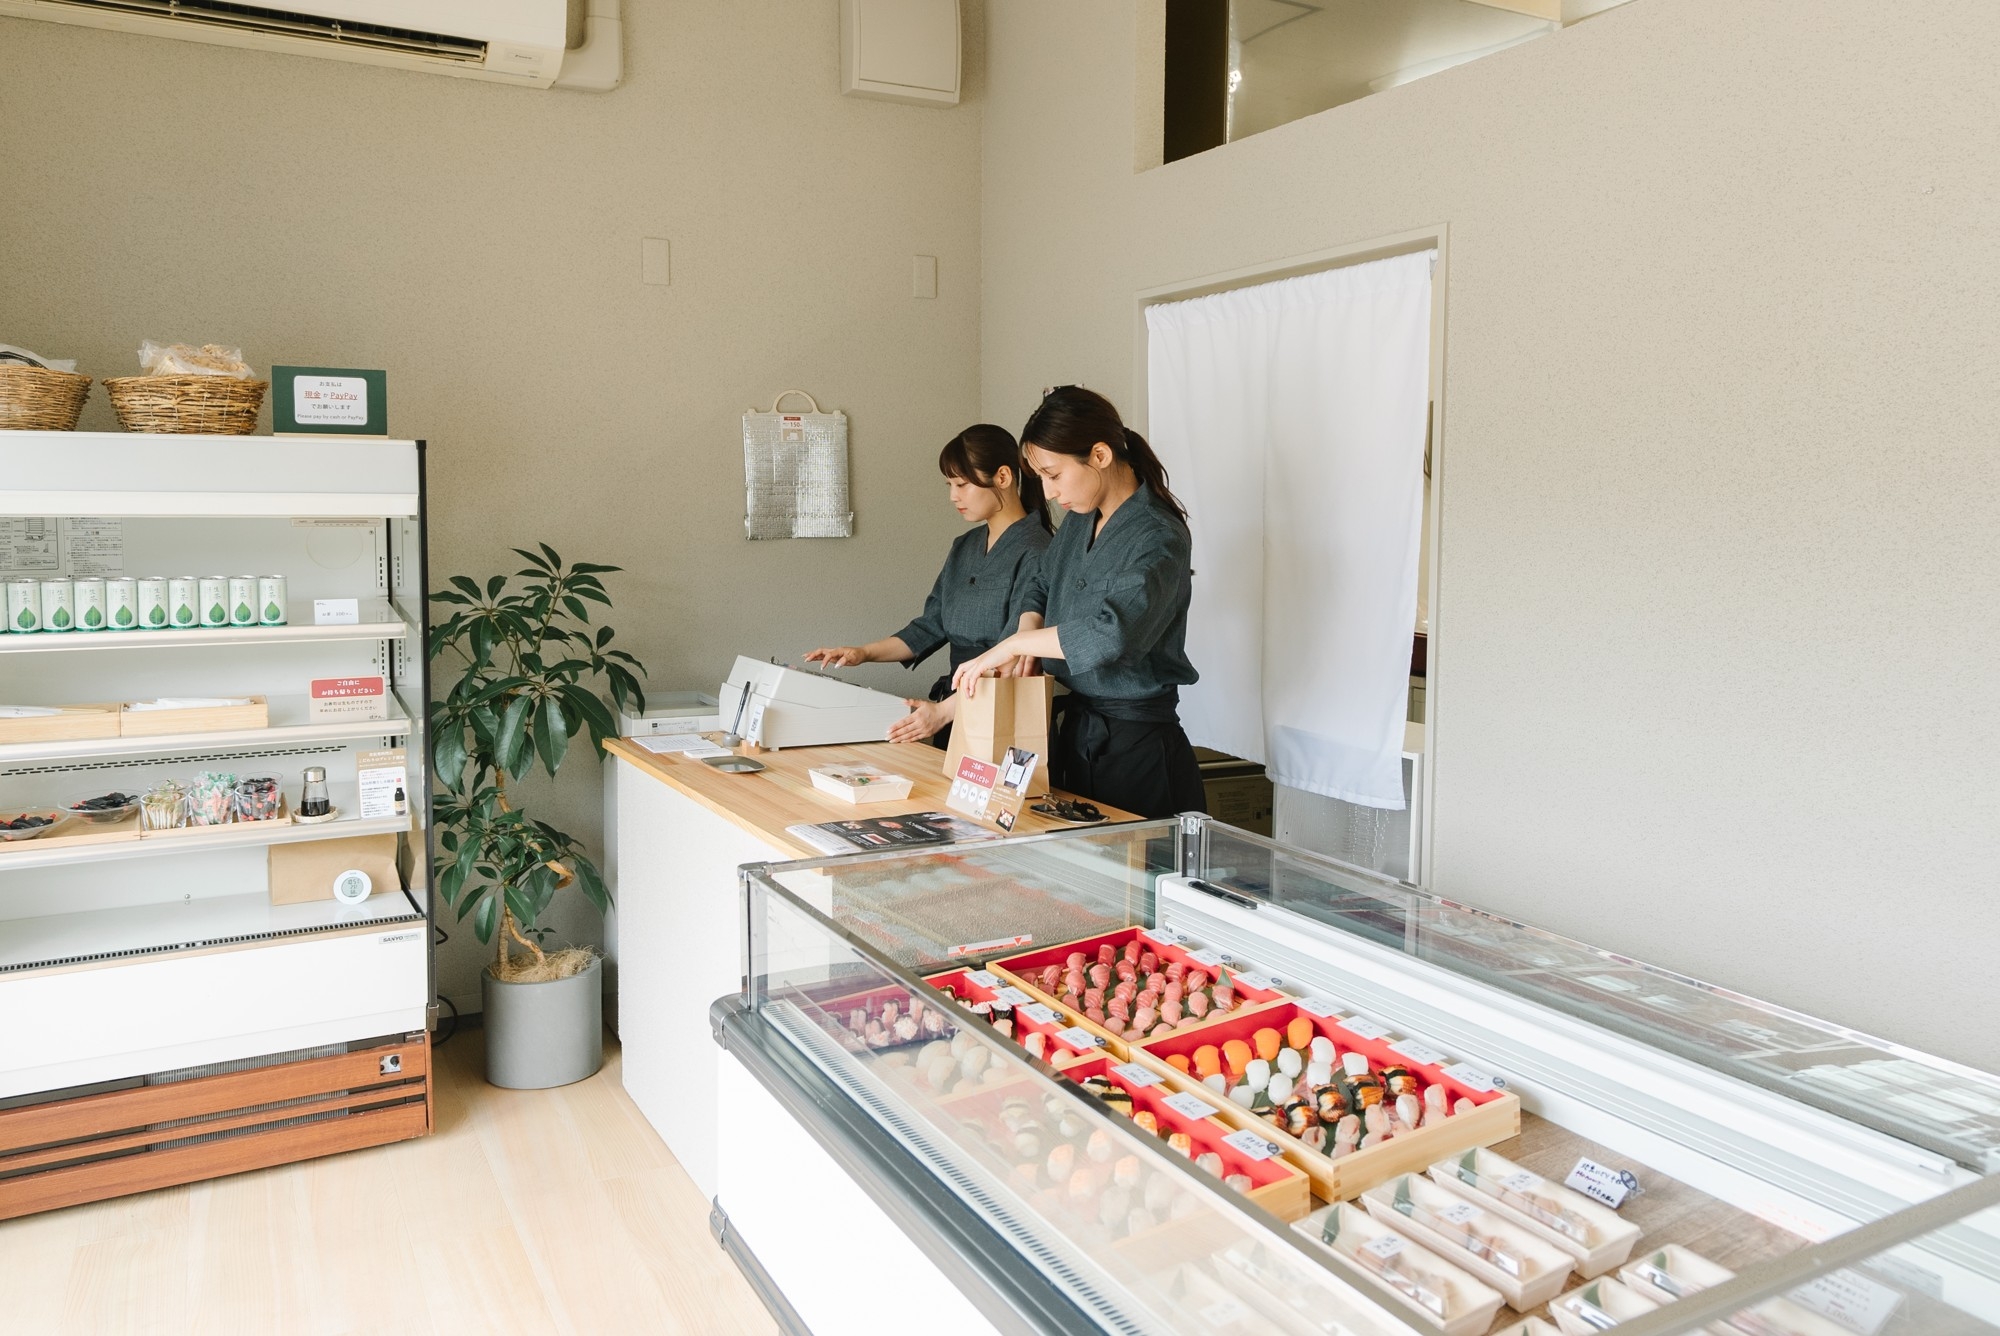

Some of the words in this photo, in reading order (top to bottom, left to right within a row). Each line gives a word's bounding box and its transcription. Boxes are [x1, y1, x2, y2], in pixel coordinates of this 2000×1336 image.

[304, 390, 321, 399] 現金
[330, 391, 358, 400] PayPay
[321, 687, 375, 696] お持ち帰りください
